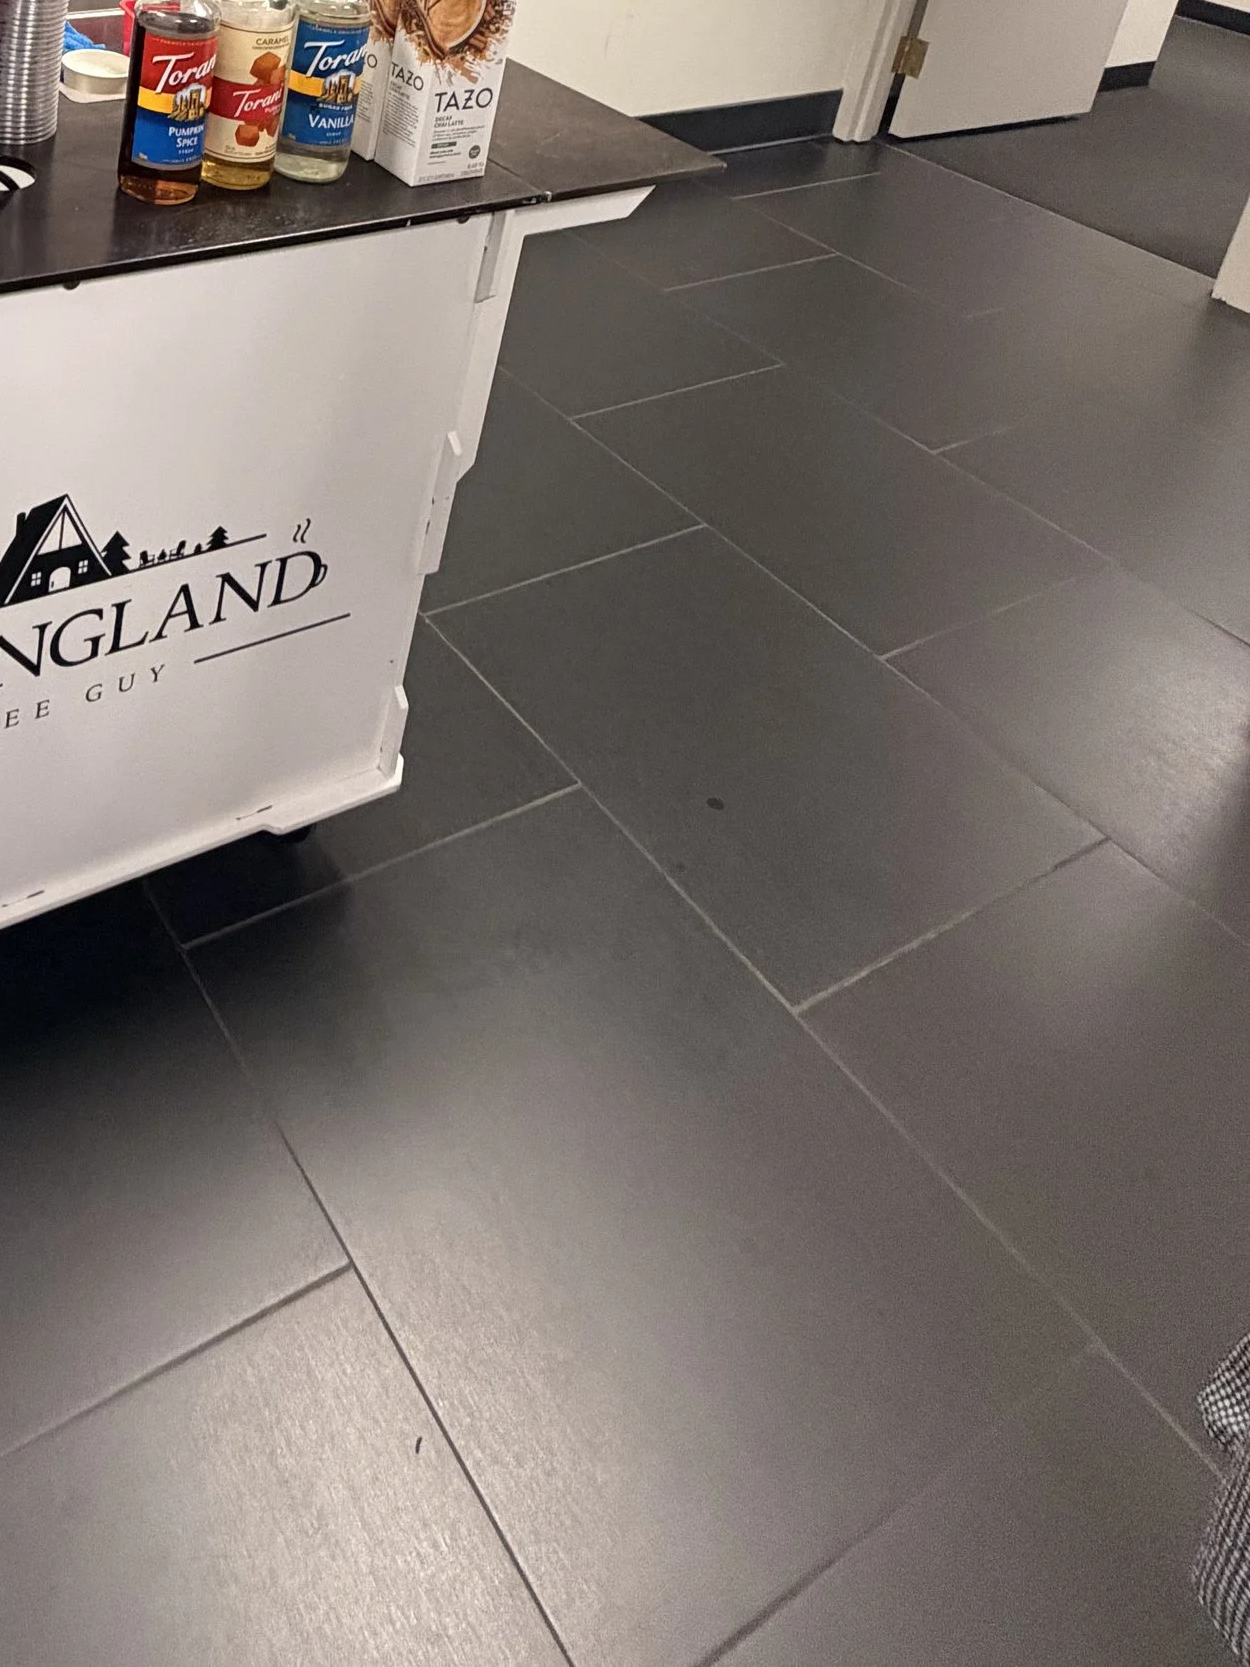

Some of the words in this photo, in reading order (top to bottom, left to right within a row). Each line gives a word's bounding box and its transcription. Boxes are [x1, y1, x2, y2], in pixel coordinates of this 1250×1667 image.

[391, 61, 424, 91] TAZO
[434, 87, 494, 113] TAZO
[175, 136, 198, 148] SPICE
[83, 663, 168, 704] GUY
